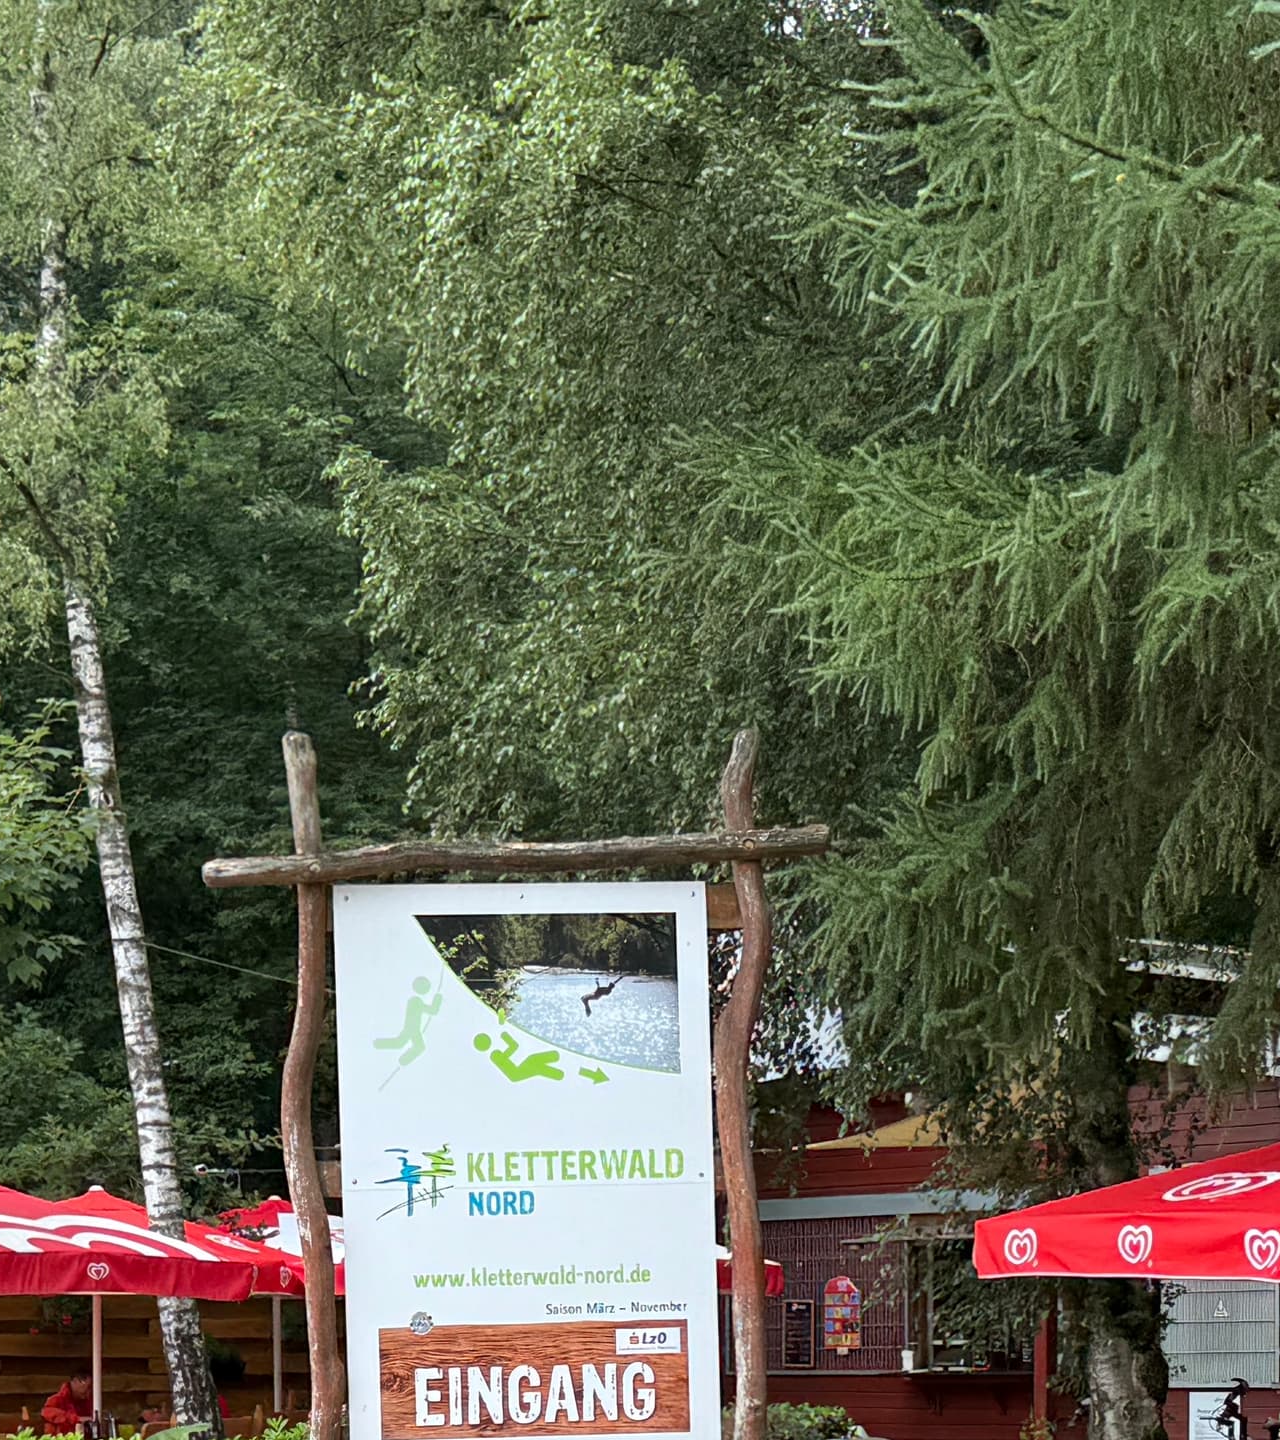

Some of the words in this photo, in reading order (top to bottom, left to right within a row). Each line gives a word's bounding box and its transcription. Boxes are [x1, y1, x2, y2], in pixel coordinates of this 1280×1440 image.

[467, 1148, 685, 1182] KLETTERWALD
[468, 1190, 535, 1216] NORD
[413, 1264, 652, 1288] www.kletterwald-nord.de
[545, 1303, 582, 1315] Saison
[586, 1301, 615, 1314] März
[631, 1301, 688, 1313] November
[415, 1361, 657, 1427] EINGANG
